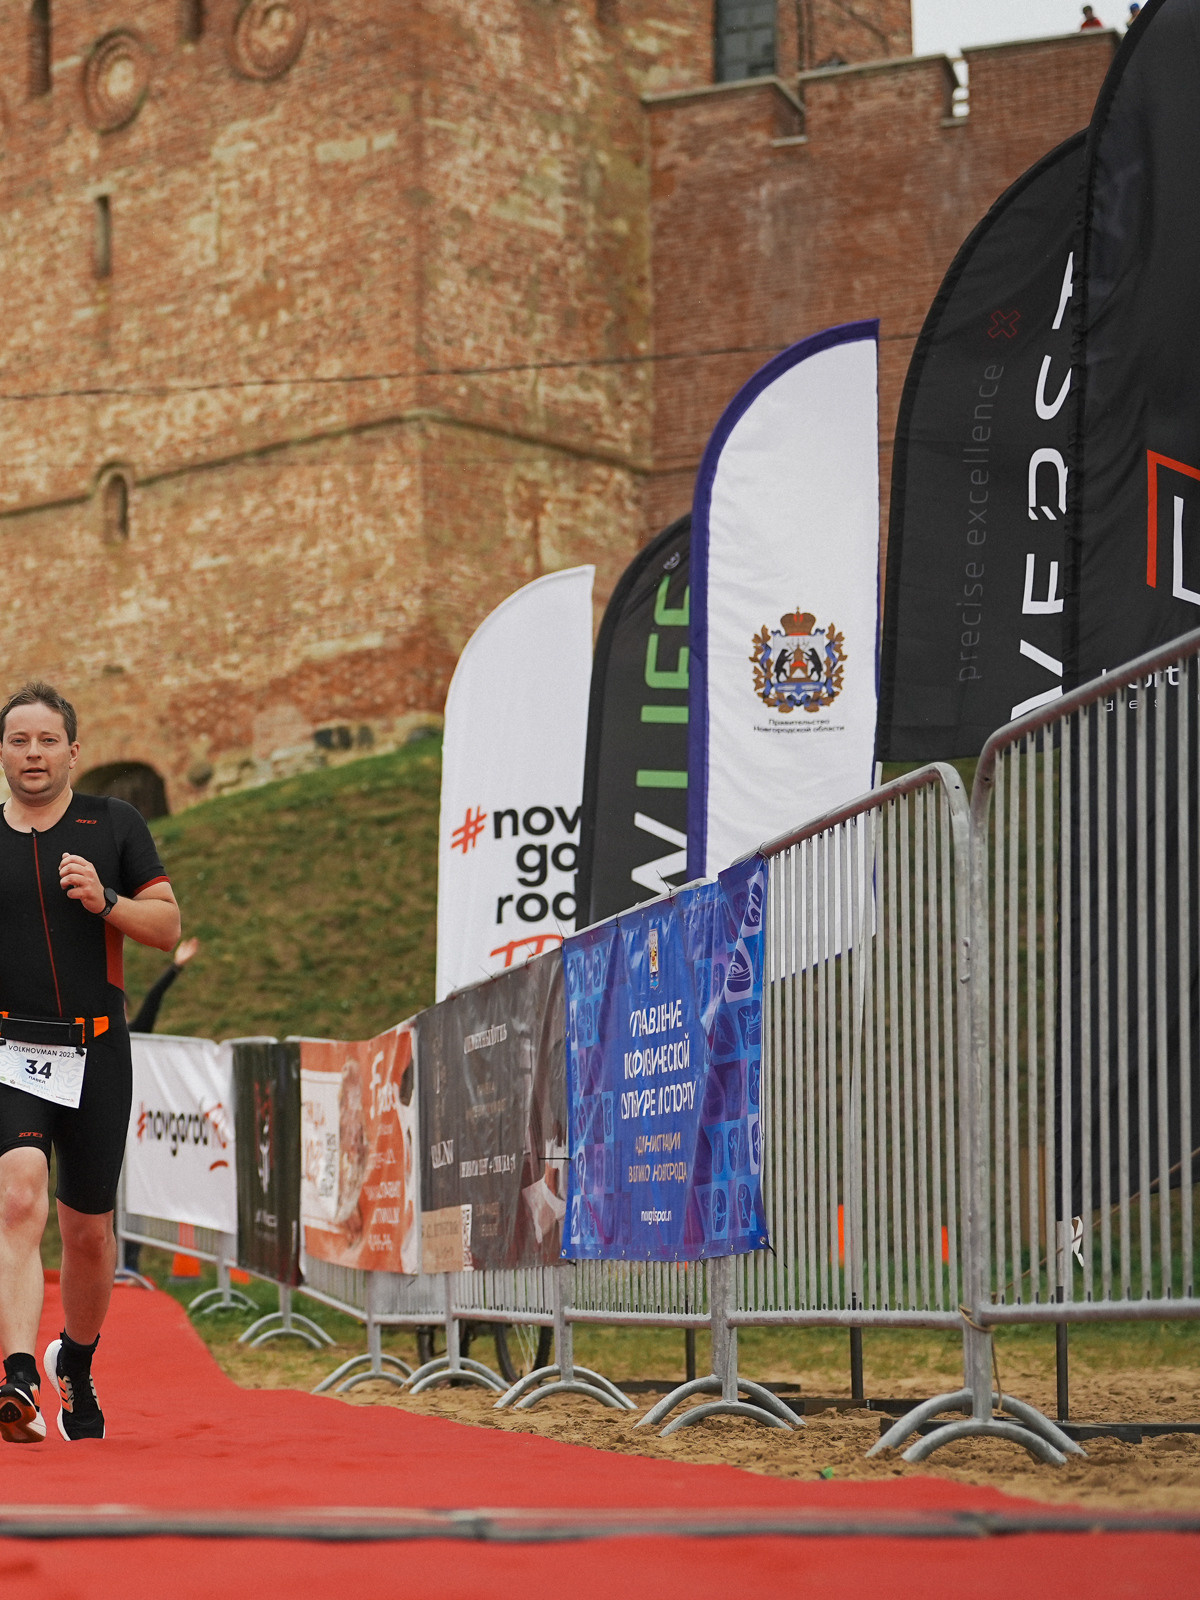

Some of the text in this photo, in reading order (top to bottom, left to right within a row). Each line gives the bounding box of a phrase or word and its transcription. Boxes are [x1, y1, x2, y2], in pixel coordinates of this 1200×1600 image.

[957, 363, 1005, 683] precise excellence
[451, 805, 583, 854] #nov
[516, 842, 579, 887] go
[8, 1044, 75, 1059] VOLKHOVMAN 2023
[24, 1058, 52, 1079] 34
[28, 1075, 46, 1085] ПАВЕЛ
